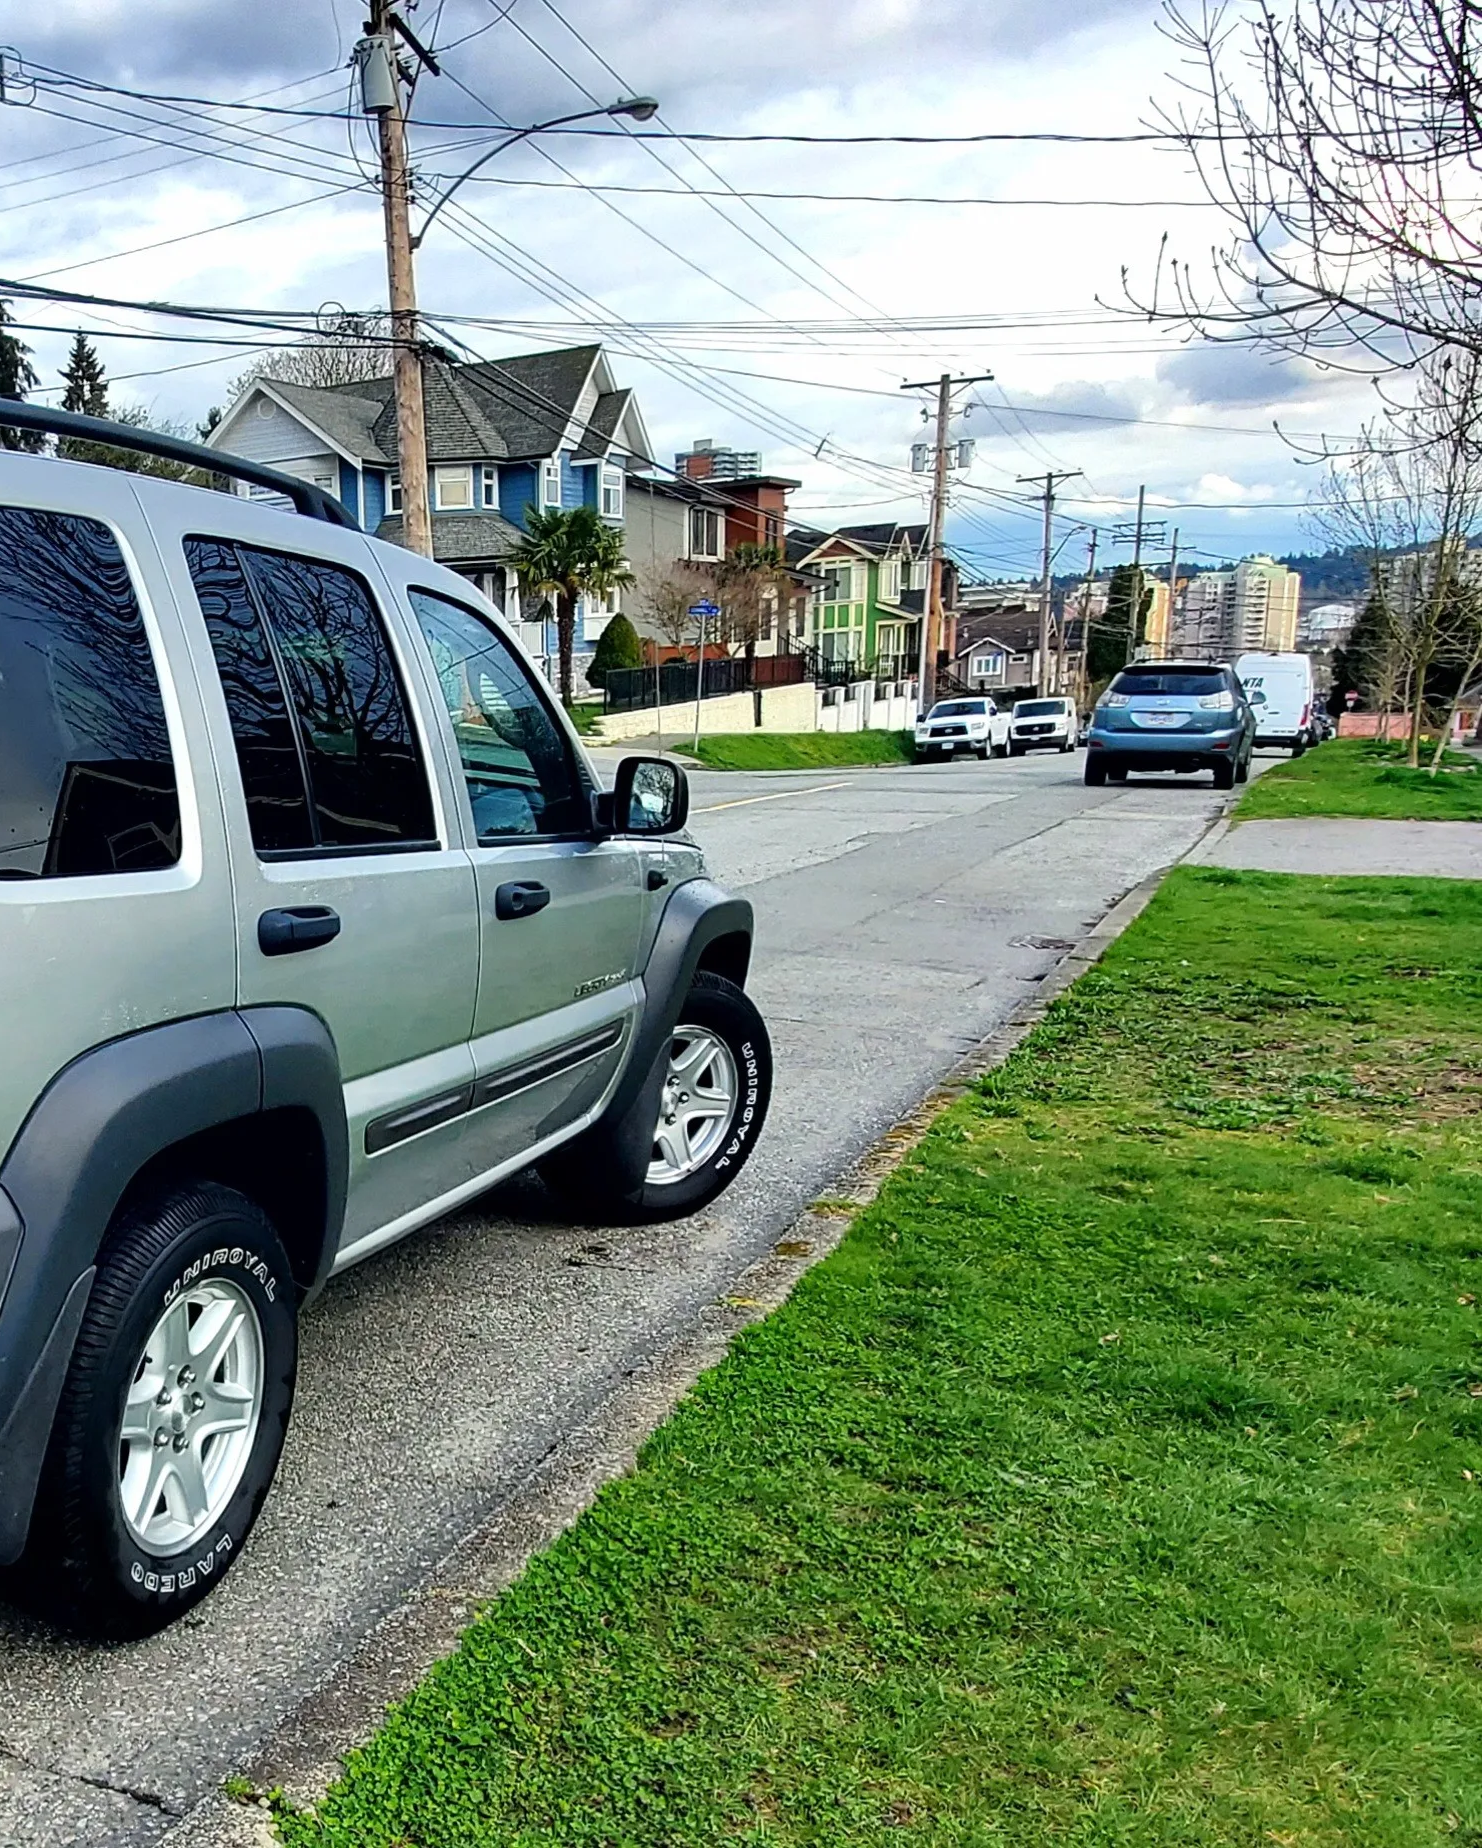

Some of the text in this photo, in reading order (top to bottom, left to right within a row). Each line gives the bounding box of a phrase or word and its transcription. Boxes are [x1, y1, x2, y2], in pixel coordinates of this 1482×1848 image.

[716, 1042, 758, 1168] UNIROYAL
[164, 1247, 277, 1306] UNIROYAL
[130, 1533, 233, 1593] LAREDO
